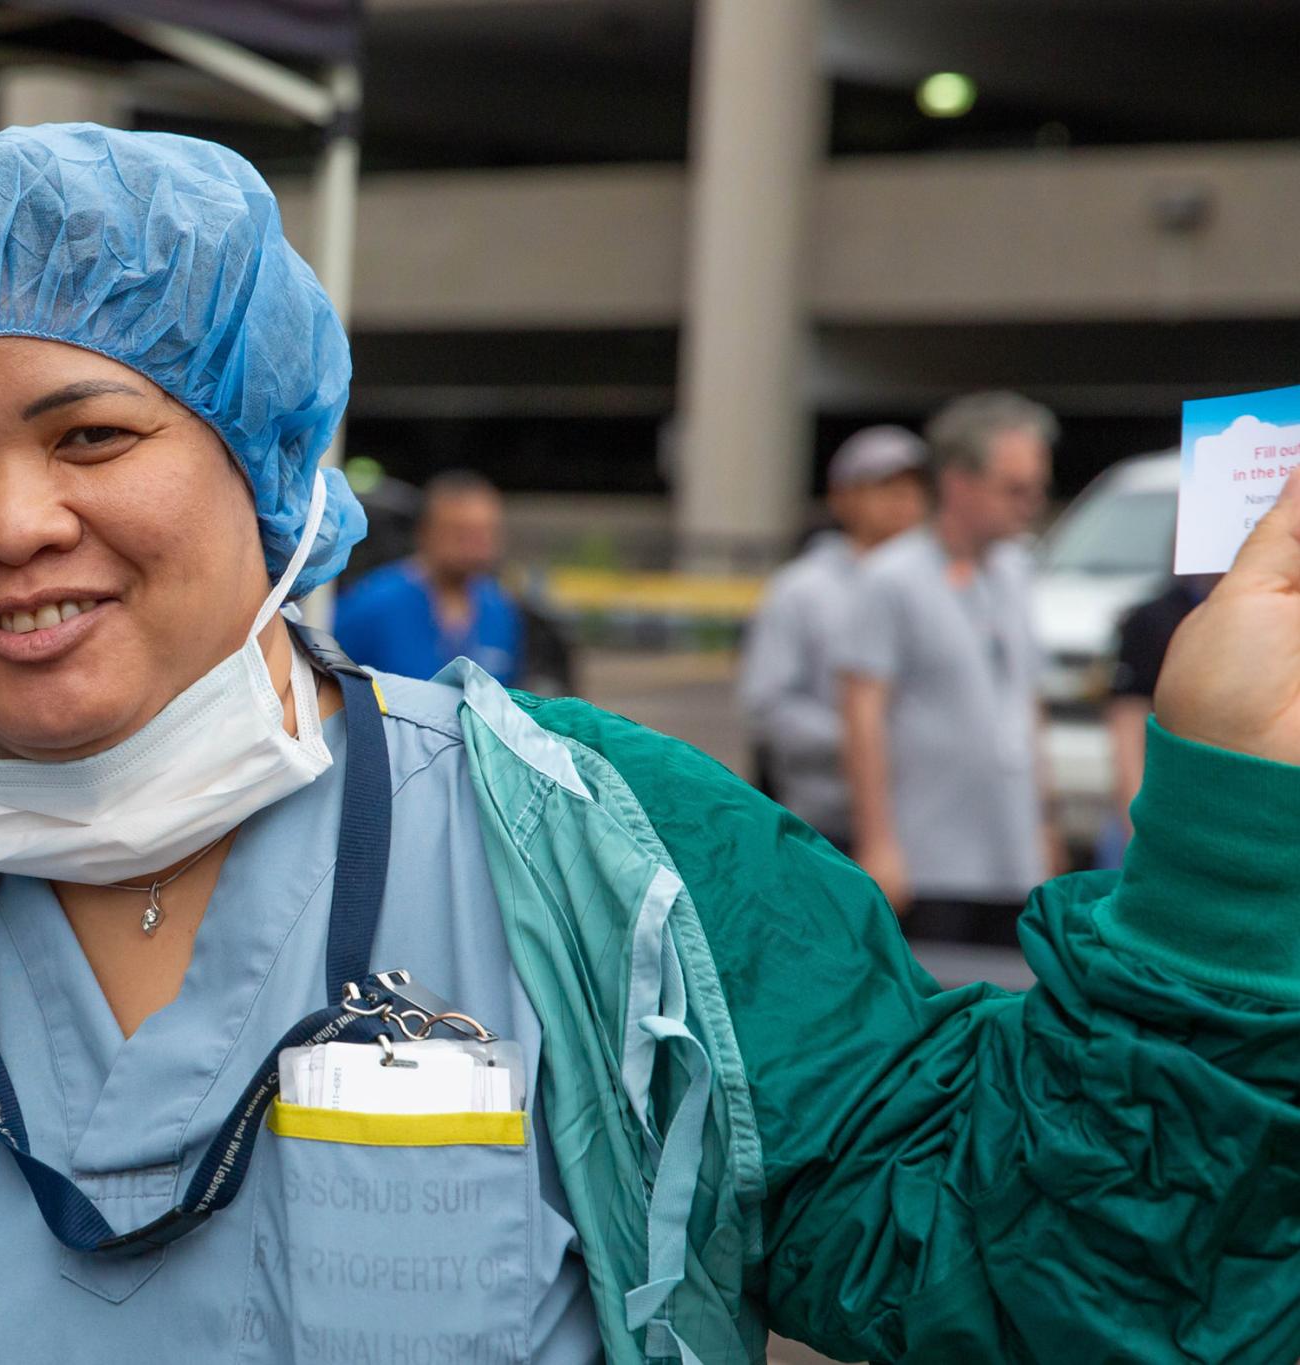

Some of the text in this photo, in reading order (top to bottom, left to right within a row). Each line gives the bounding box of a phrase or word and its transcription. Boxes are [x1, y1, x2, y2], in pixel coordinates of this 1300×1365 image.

[1254, 446, 1276, 460] Fill
[1233, 469, 1246, 481] in
[1251, 467, 1276, 480] the
[1245, 494, 1278, 505] Nam
[244, 1084, 269, 1118] Joseph
[234, 1119, 248, 1139] and
[203, 1165, 231, 1204] Lebovic
[308, 1171, 413, 1214] SCRUB
[421, 1178, 487, 1215] SUIT
[306, 1246, 469, 1293] PROPERTY
